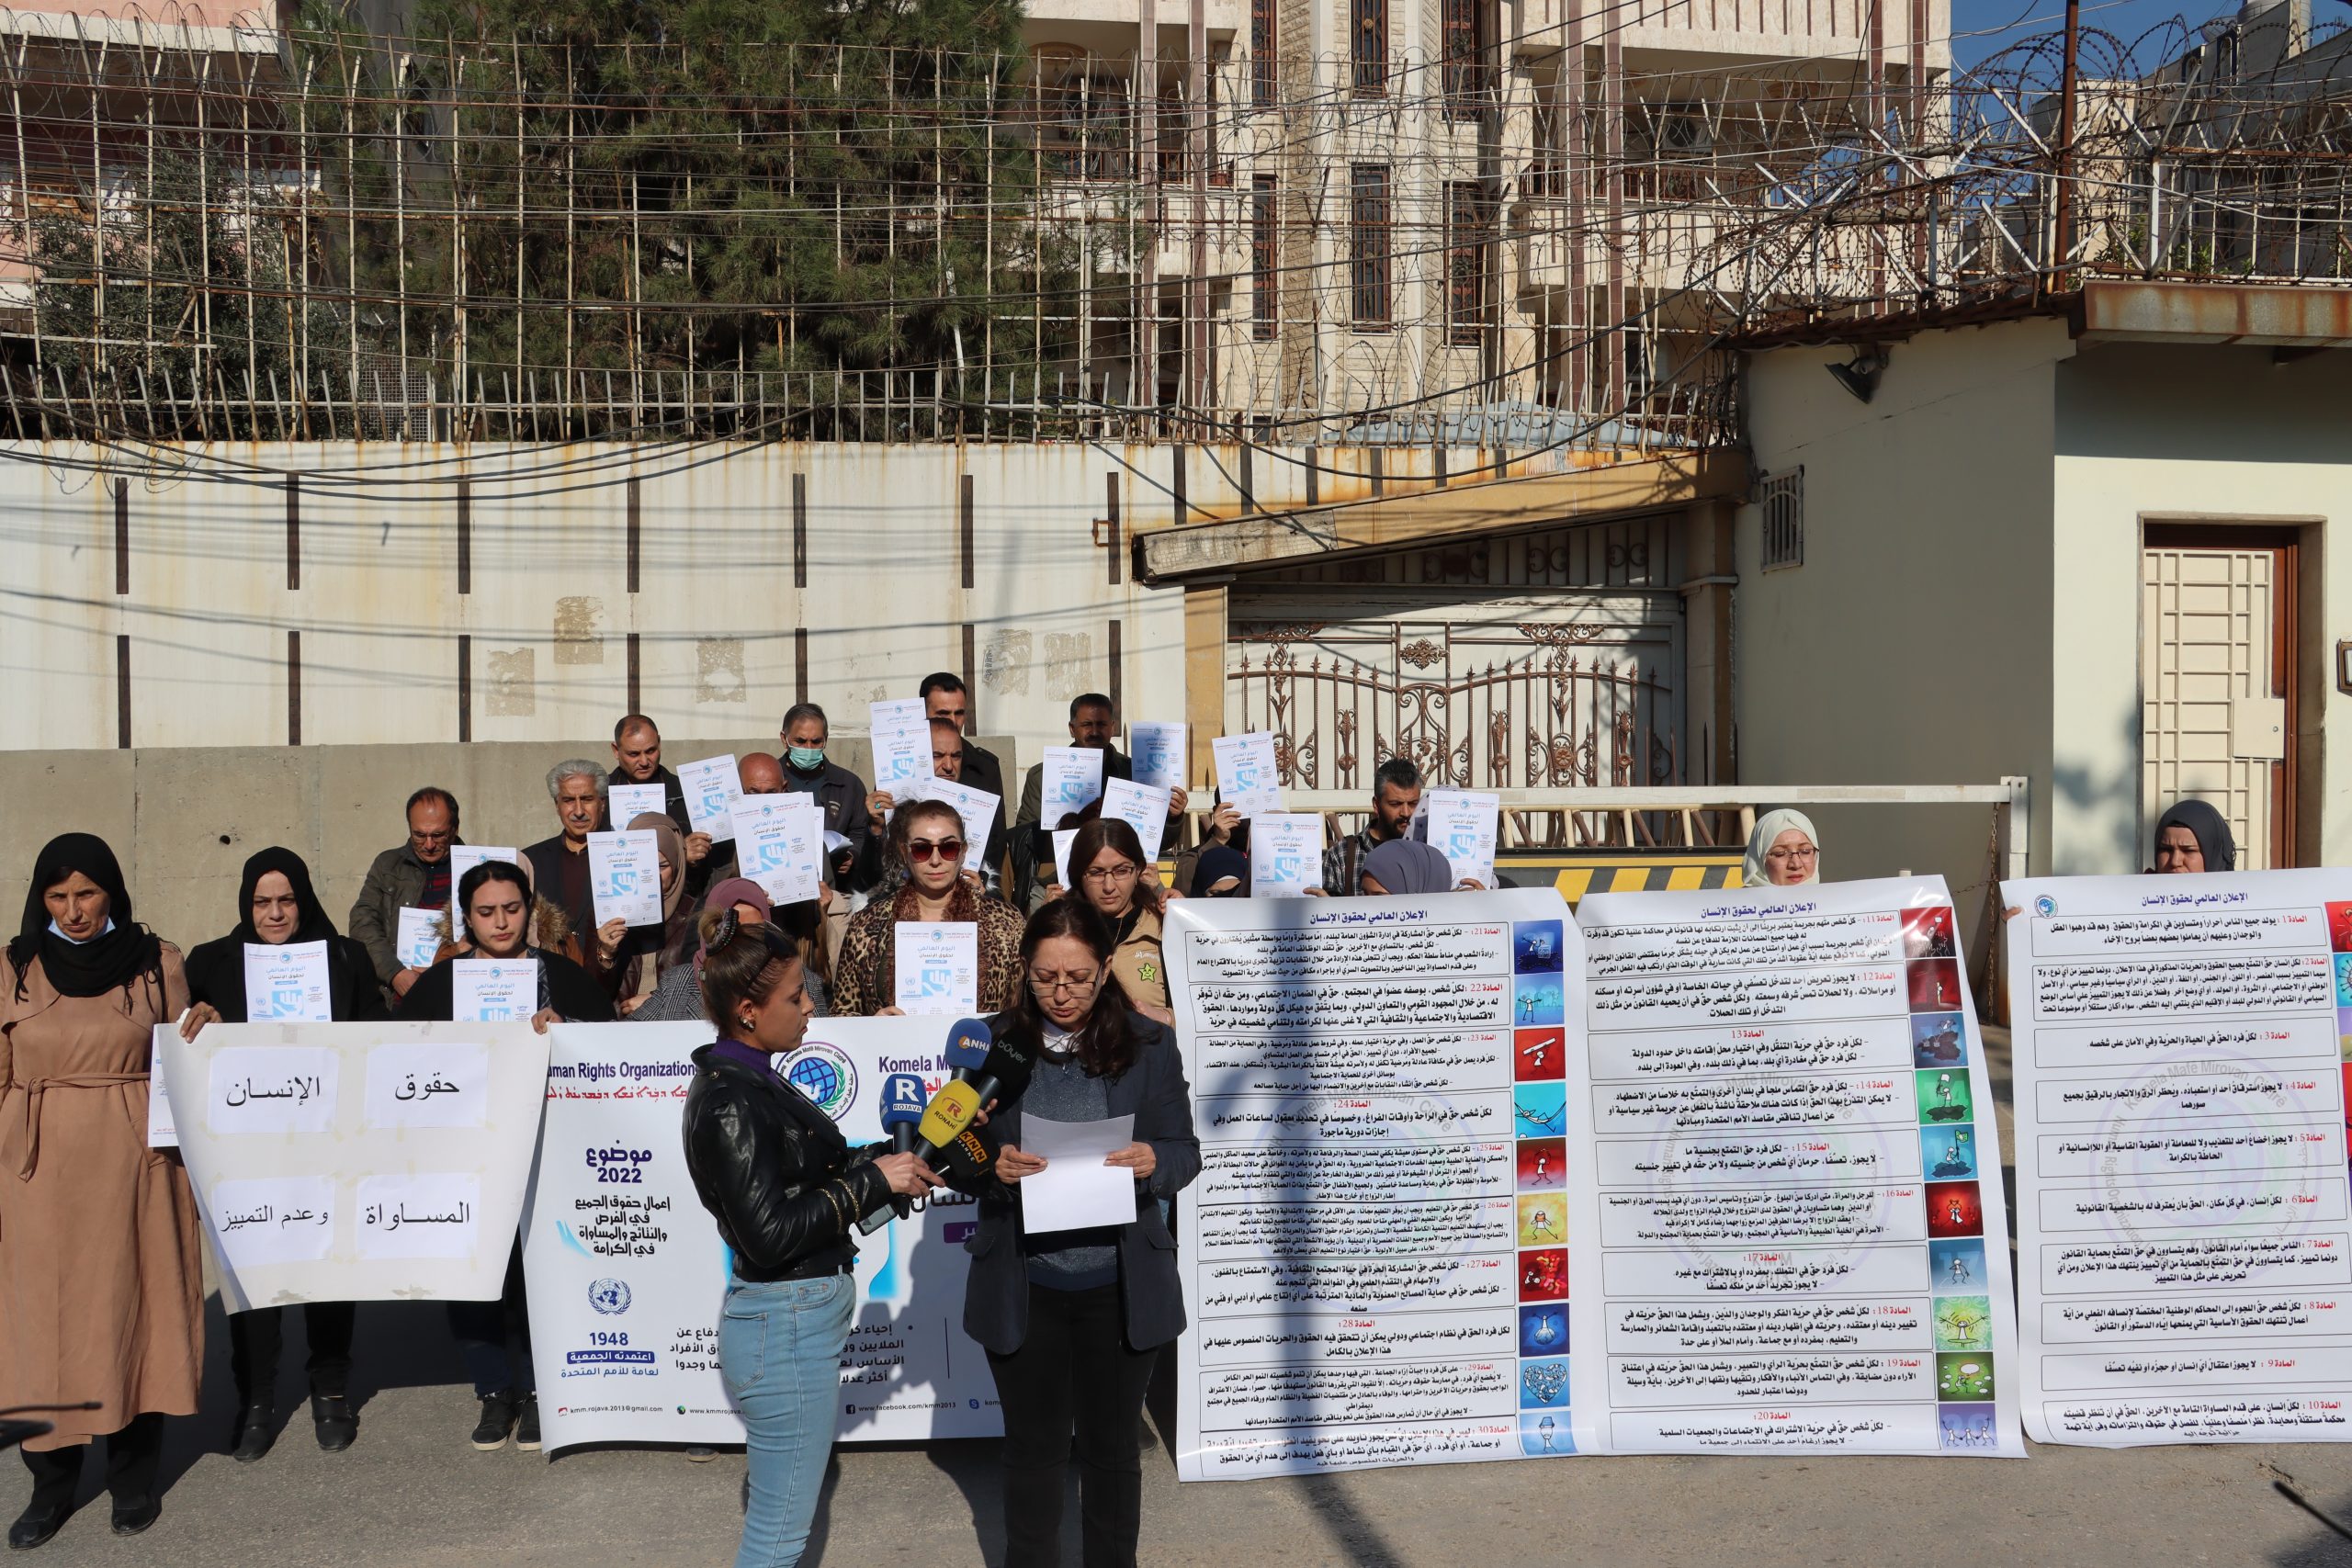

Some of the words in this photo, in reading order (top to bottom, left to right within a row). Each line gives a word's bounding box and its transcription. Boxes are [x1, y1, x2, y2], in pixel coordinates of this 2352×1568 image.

[2142, 895, 2168, 906] الإنسان
[2171, 894, 2192, 905] لحقوق
[2195, 894, 2222, 906] العالمي
[2223, 893, 2247, 904] الإعلان
[1702, 907, 1730, 919] الإنسان
[1732, 907, 1756, 917] لحقوق
[1758, 906, 1788, 919] العالمي
[1790, 902, 1816, 914] الإعلان
[1310, 913, 1340, 925] الإنسان
[1341, 912, 1366, 923] لحقوق
[1369, 912, 1397, 925] العالمي
[1400, 910, 1428, 921] الإعلان
[2289, 915, 2307, 923] المادة
[2070, 923, 2086, 931] وهبوا
[2087, 922, 2096, 931] قد
[2098, 922, 2109, 931] وهم
[2141, 920, 2163, 931] الكرامة
[2165, 920, 2173, 931] في
[2174, 919, 2203, 930] ومتساوين
[2224, 918, 2243, 927] الناس
[2245, 918, 2260, 927] جميع
[2262, 918, 2277, 926] يولد
[2051, 925, 2067, 933] العقل
[1744, 1030, 1764, 1038] المادة
[2271, 1032, 2290, 1040] المادة
[963, 1038, 989, 1053] ANHA
[879, 1056, 932, 1072] Komela
[548, 1066, 574, 1077] uman
[578, 1063, 616, 1082] Rights
[620, 1061, 695, 1081] Organization
[226, 1076, 321, 1106] الإنسان
[395, 1072, 459, 1100] حقوق
[896, 1078, 919, 1101] R
[1351, 1100, 1371, 1108] المادة
[960, 1132, 986, 1162] KNN
[1695, 1146, 1720, 1156] بجنسية
[1722, 1146, 1742, 1156] التمتع
[1757, 1145, 1767, 1156] فرد
[1770, 1145, 1781, 1154] لكل
[1809, 1143, 1829, 1151] المادة
[586, 1140, 652, 1168] موضوع
[597, 1168, 642, 1183] 2022
[575, 1195, 607, 1210] الجميع
[610, 1195, 641, 1210] حقوق
[2299, 1195, 2317, 1203] المادة
[220, 1204, 274, 1232] التمييز
[282, 1205, 328, 1231] وعدم
[367, 1201, 470, 1230] المساواة
[595, 1211, 626, 1225] الفرص
[629, 1212, 650, 1226] في
[580, 1225, 628, 1240] والمساواة
[630, 1227, 667, 1242] والنتائج
[594, 1241, 631, 1257] الكرامة
[634, 1243, 654, 1258] في
[1891, 1306, 1911, 1314] المادة
[677, 1328, 692, 1338] عن
[695, 1327, 718, 1340] دفاع
[865, 1324, 891, 1336] إحياء
[1409, 1330, 1438, 1340] اجتماعي
[1440, 1329, 1455, 1338] نظام
[1458, 1328, 1466, 1337] في
[1485, 1327, 1496, 1337] فرد
[1498, 1326, 1510, 1336] لكل
[590, 1332, 628, 1346] 1948
[1370, 1334, 1386, 1343] يمكن
[1388, 1332, 1408, 1342] ودولي
[670, 1344, 703, 1353] الأفراد
[860, 1340, 903, 1352] الملايين
[571, 1352, 611, 1361] الجمعية
[615, 1352, 650, 1360] اعتمدته
[676, 1359, 705, 1371] وجدوا
[856, 1358, 904, 1368] الأساس
[1887, 1359, 1898, 1367] 19
[561, 1367, 599, 1378] المتحدة
[604, 1366, 628, 1377] للأمم
[867, 1371, 888, 1384] أكثر
[859, 1403, 956, 1412] www.facebook.com/kmm2013
[2309, 1401, 2319, 1409] 10
[2321, 1401, 2341, 1409] المادة
